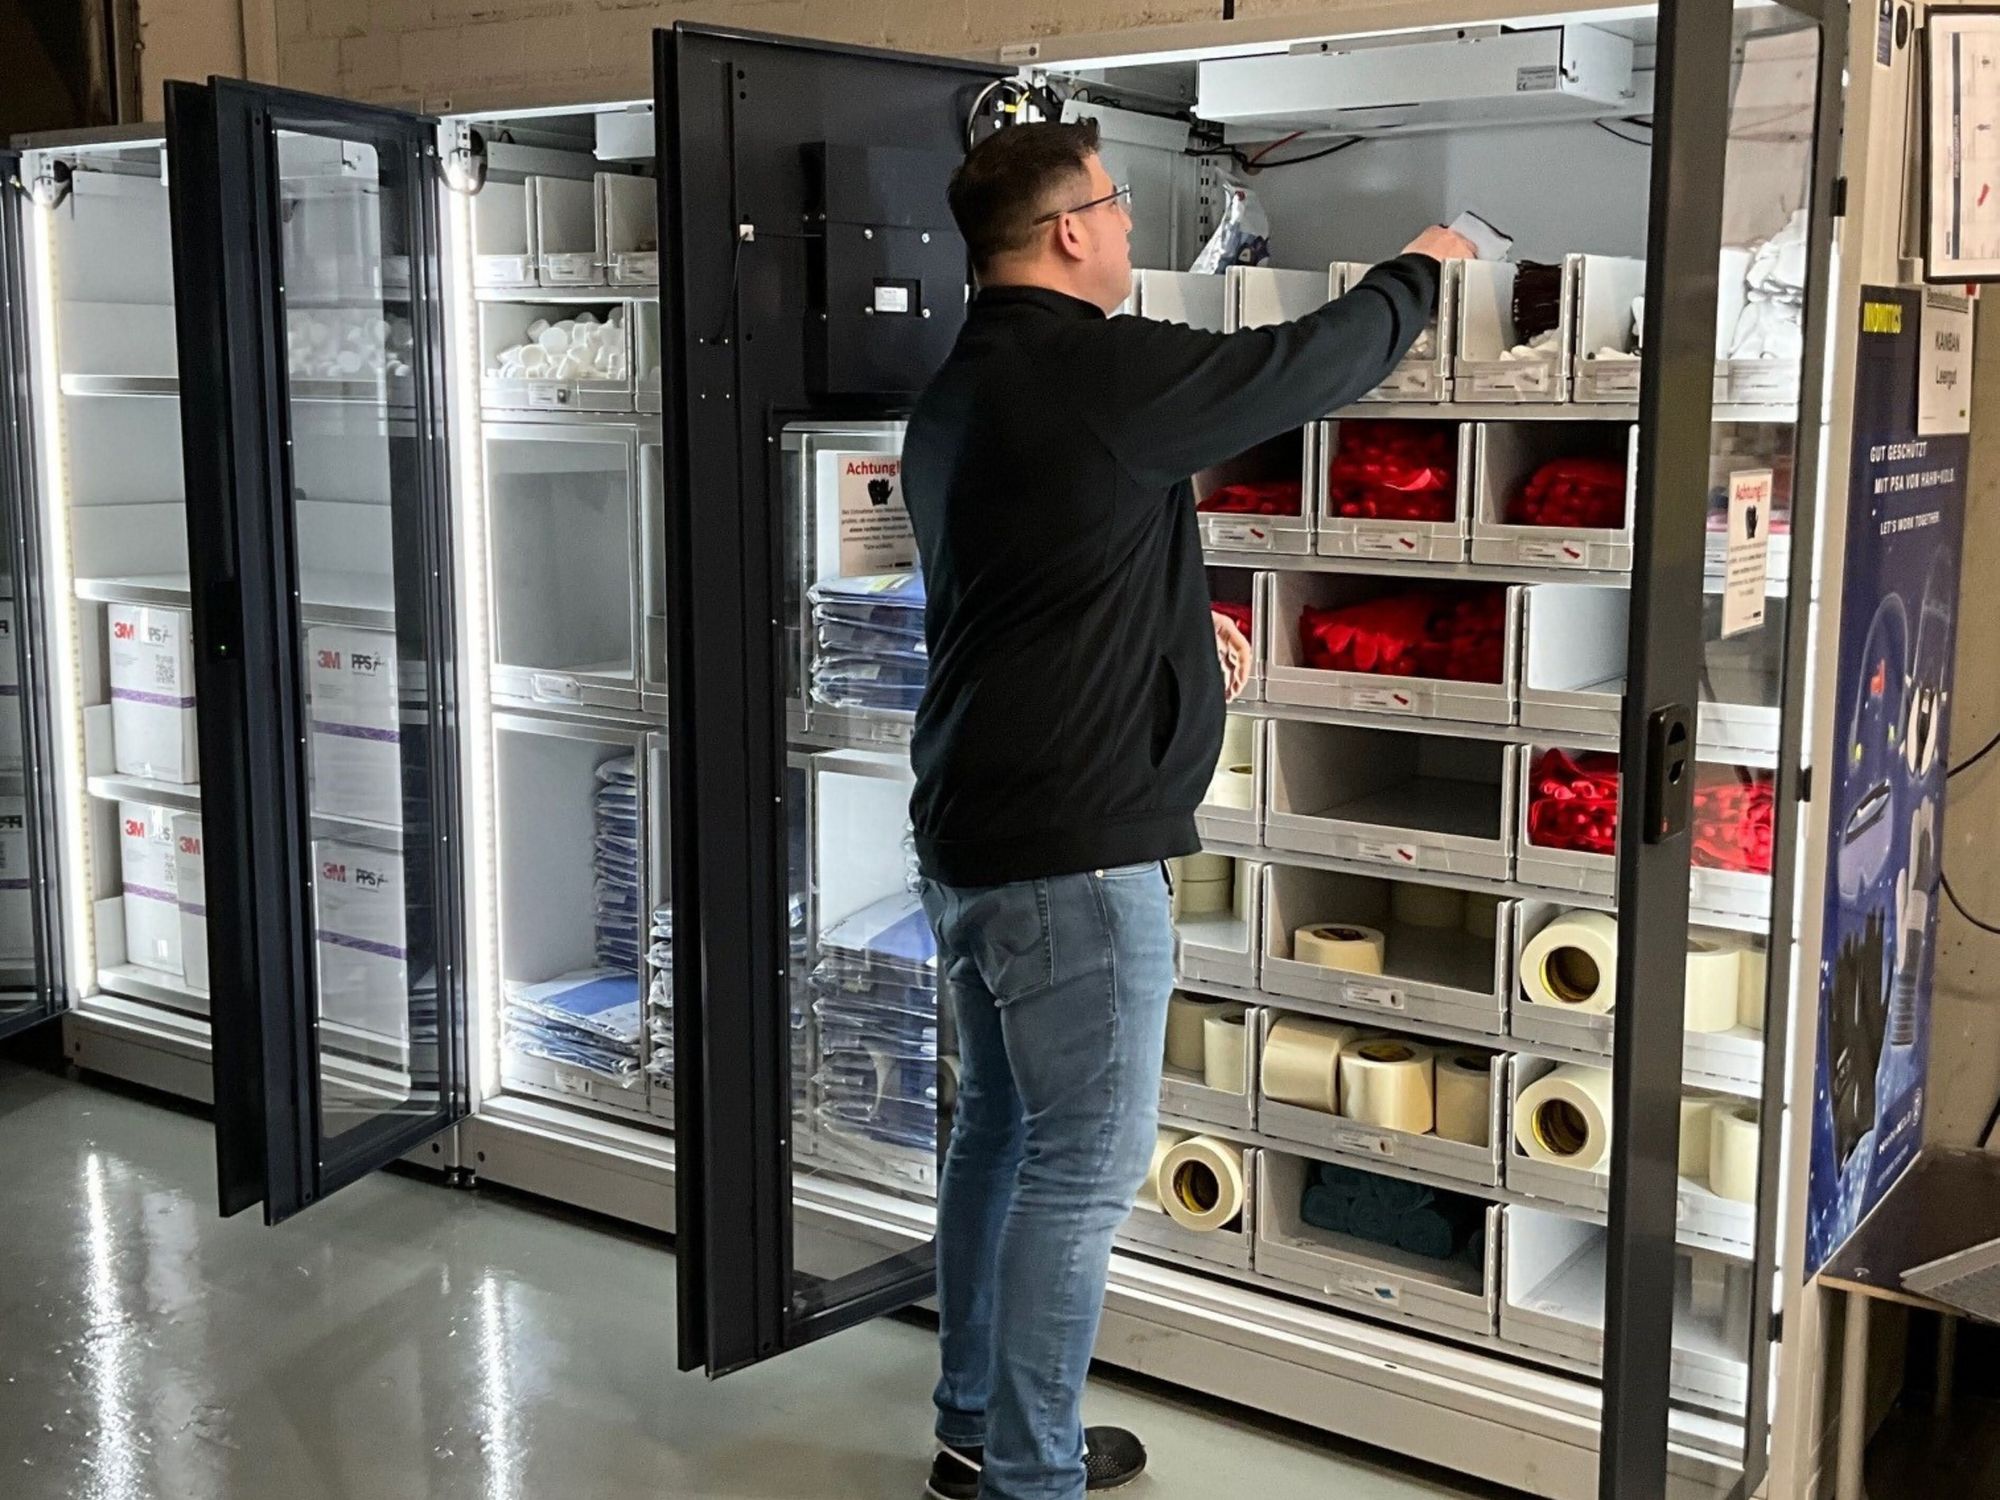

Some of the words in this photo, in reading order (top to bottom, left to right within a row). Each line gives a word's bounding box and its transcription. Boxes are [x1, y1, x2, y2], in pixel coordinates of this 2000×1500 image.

[1870, 446, 1886, 462] GUT
[1874, 477, 1889, 494] MIT
[1890, 475, 1904, 492] PSA
[114, 622, 135, 640] 3M
[317, 649, 341, 670] 3M
[351, 653, 372, 671] PPS
[126, 819, 145, 838] 3M
[179, 836, 201, 855] 3M
[323, 862, 346, 883] 3M
[356, 868, 376, 886] PPS
